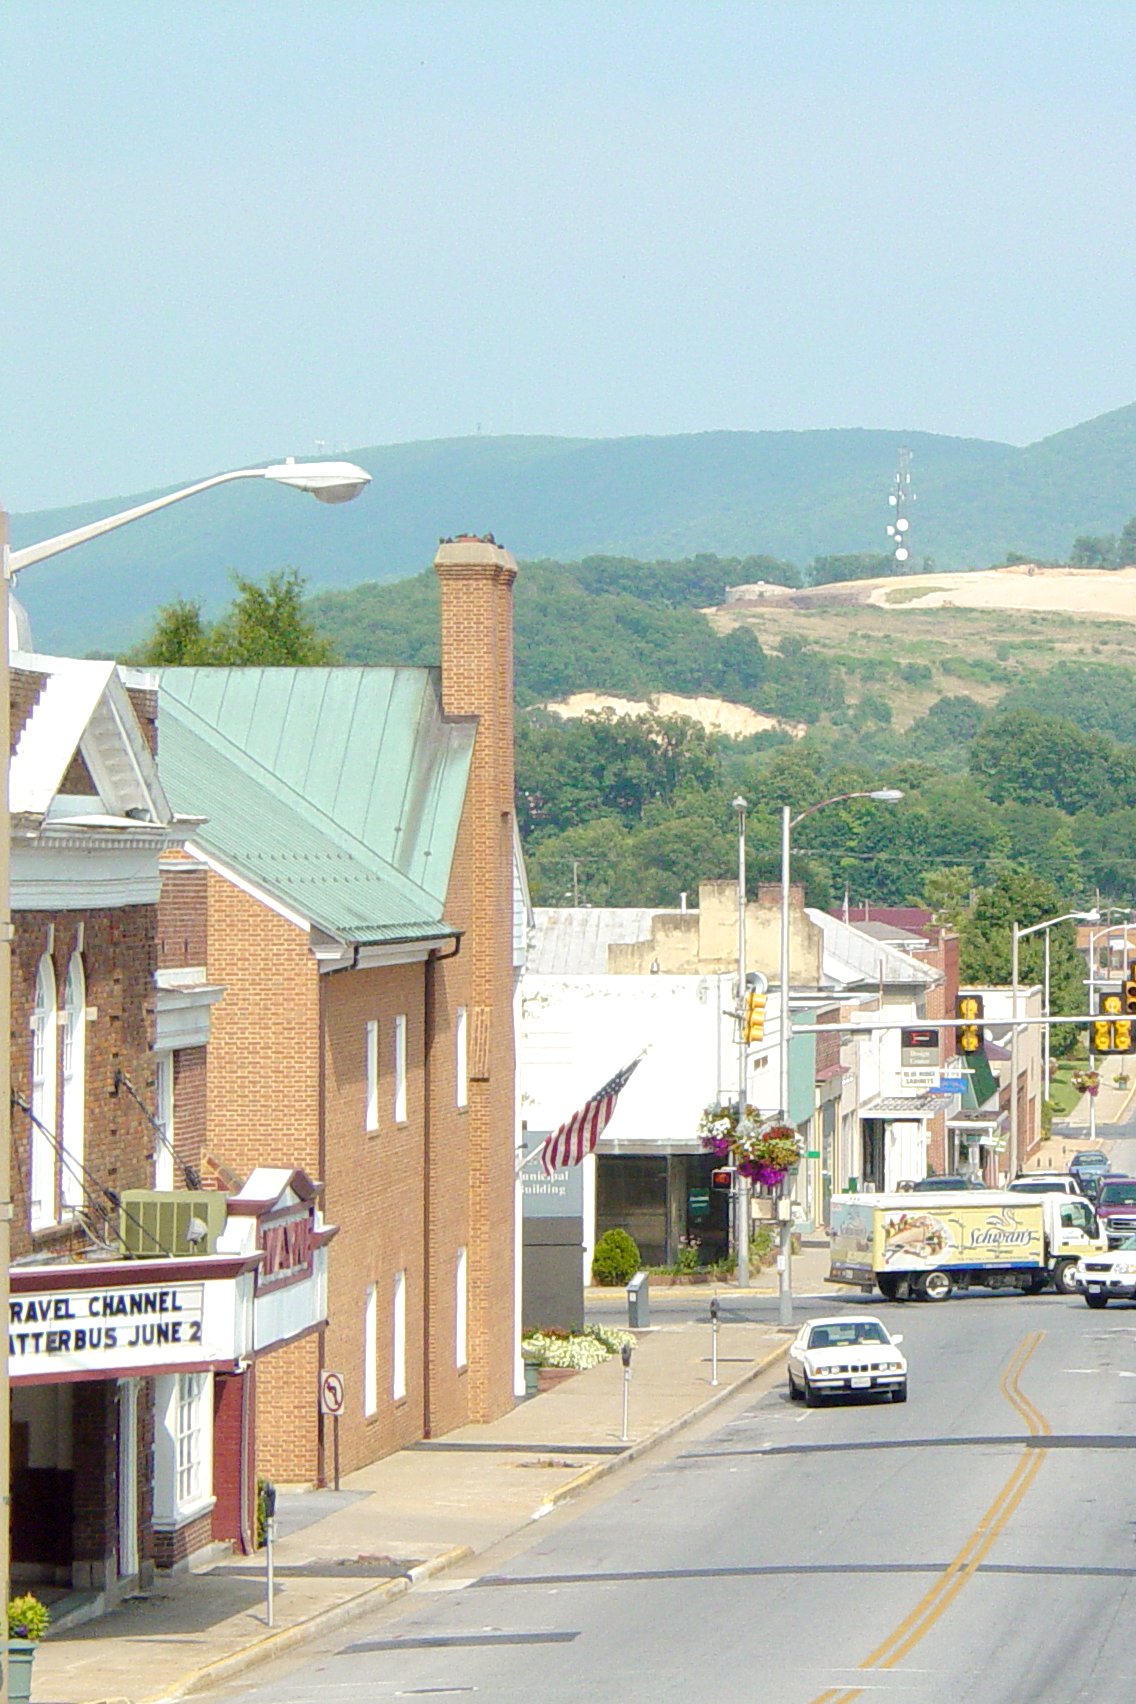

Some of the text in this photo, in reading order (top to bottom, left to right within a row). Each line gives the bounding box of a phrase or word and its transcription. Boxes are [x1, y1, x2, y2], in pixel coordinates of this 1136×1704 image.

[519, 1170, 569, 1183] unicpal
[9, 1290, 183, 1324] RAVEL CHANNEL
[127, 1321, 183, 1347] JUNE
[188, 1320, 202, 1343] 2
